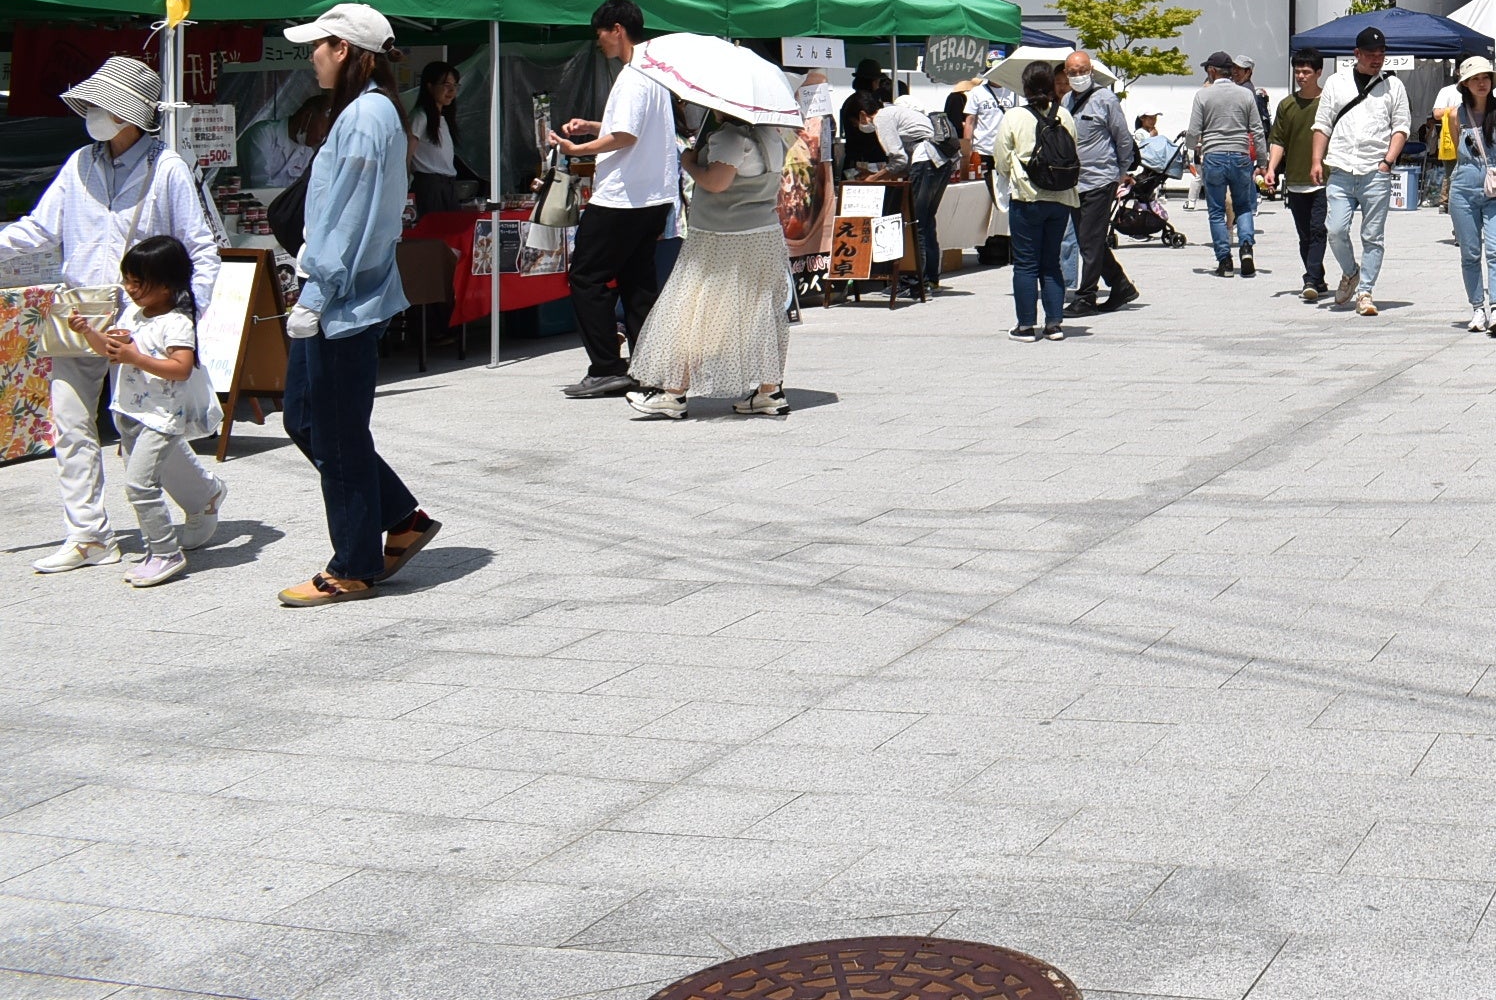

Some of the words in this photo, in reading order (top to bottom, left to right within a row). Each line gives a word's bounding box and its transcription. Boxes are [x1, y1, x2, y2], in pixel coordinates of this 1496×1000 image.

[265, 46, 313, 61] ミュースリ
[796, 44, 833, 59] えん卓
[929, 37, 985, 68] TERADA
[943, 62, 967, 71] SHOP
[831, 221, 858, 276] えん卓
